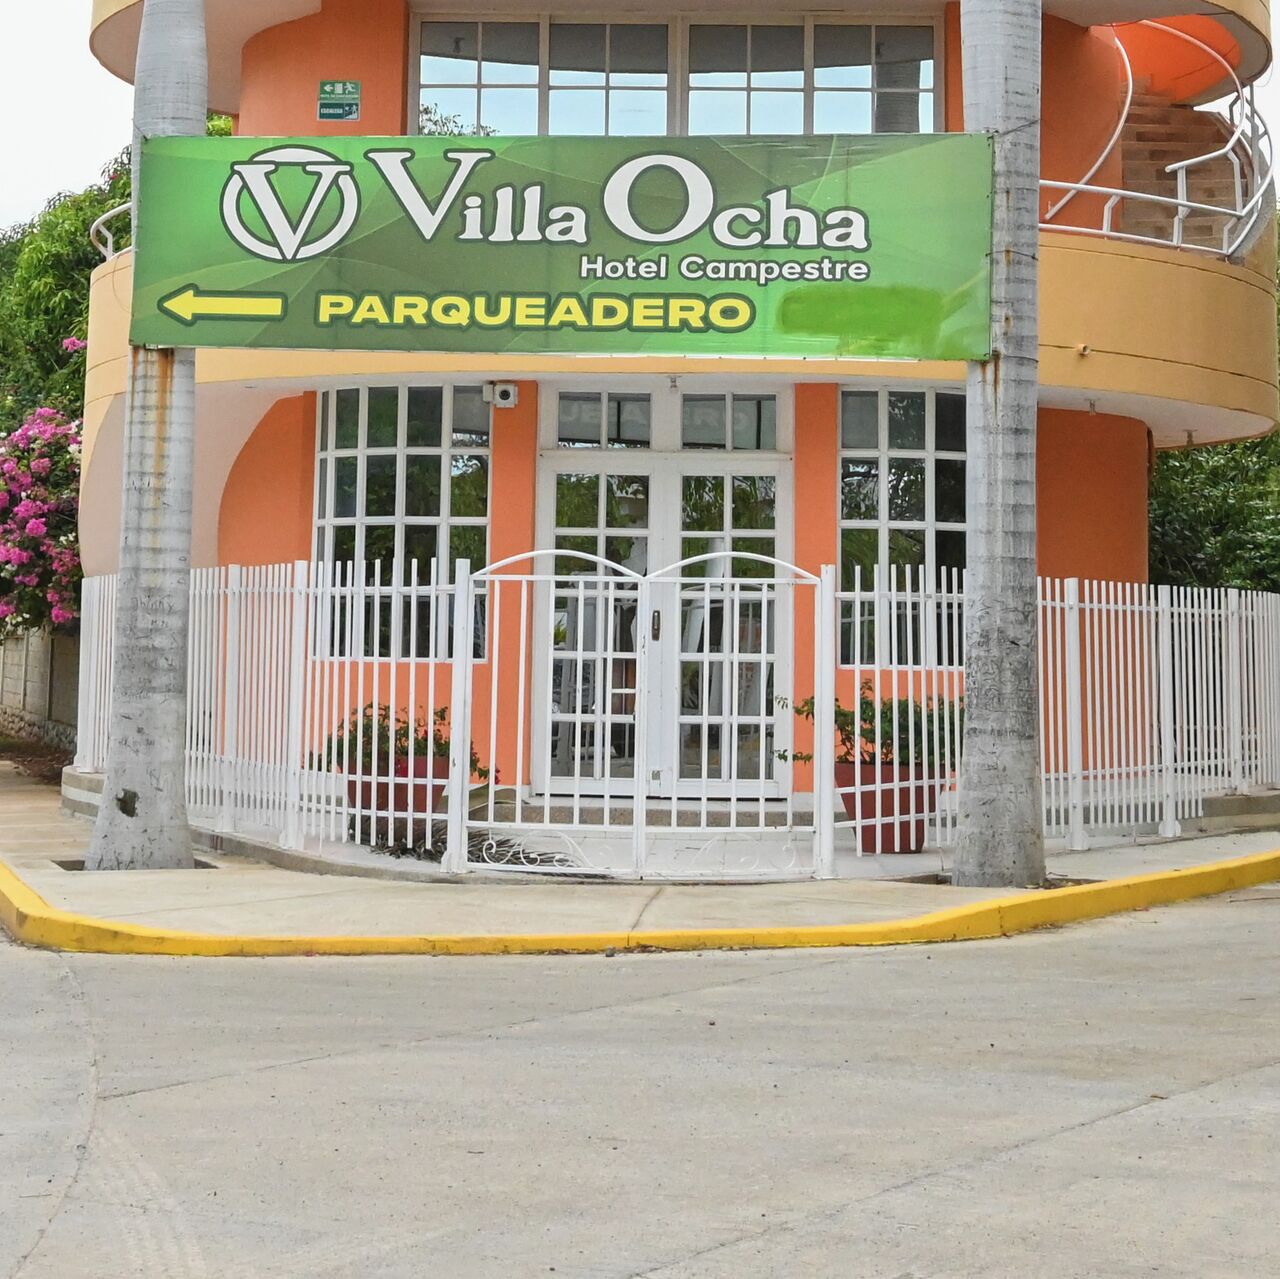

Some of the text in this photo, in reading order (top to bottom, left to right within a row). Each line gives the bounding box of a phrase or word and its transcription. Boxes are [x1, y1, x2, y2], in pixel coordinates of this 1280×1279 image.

[368, 152, 869, 249] Villa Ocha
[581, 256, 869, 284] Hotel Campestre
[319, 295, 752, 328] PARQUEADERO
